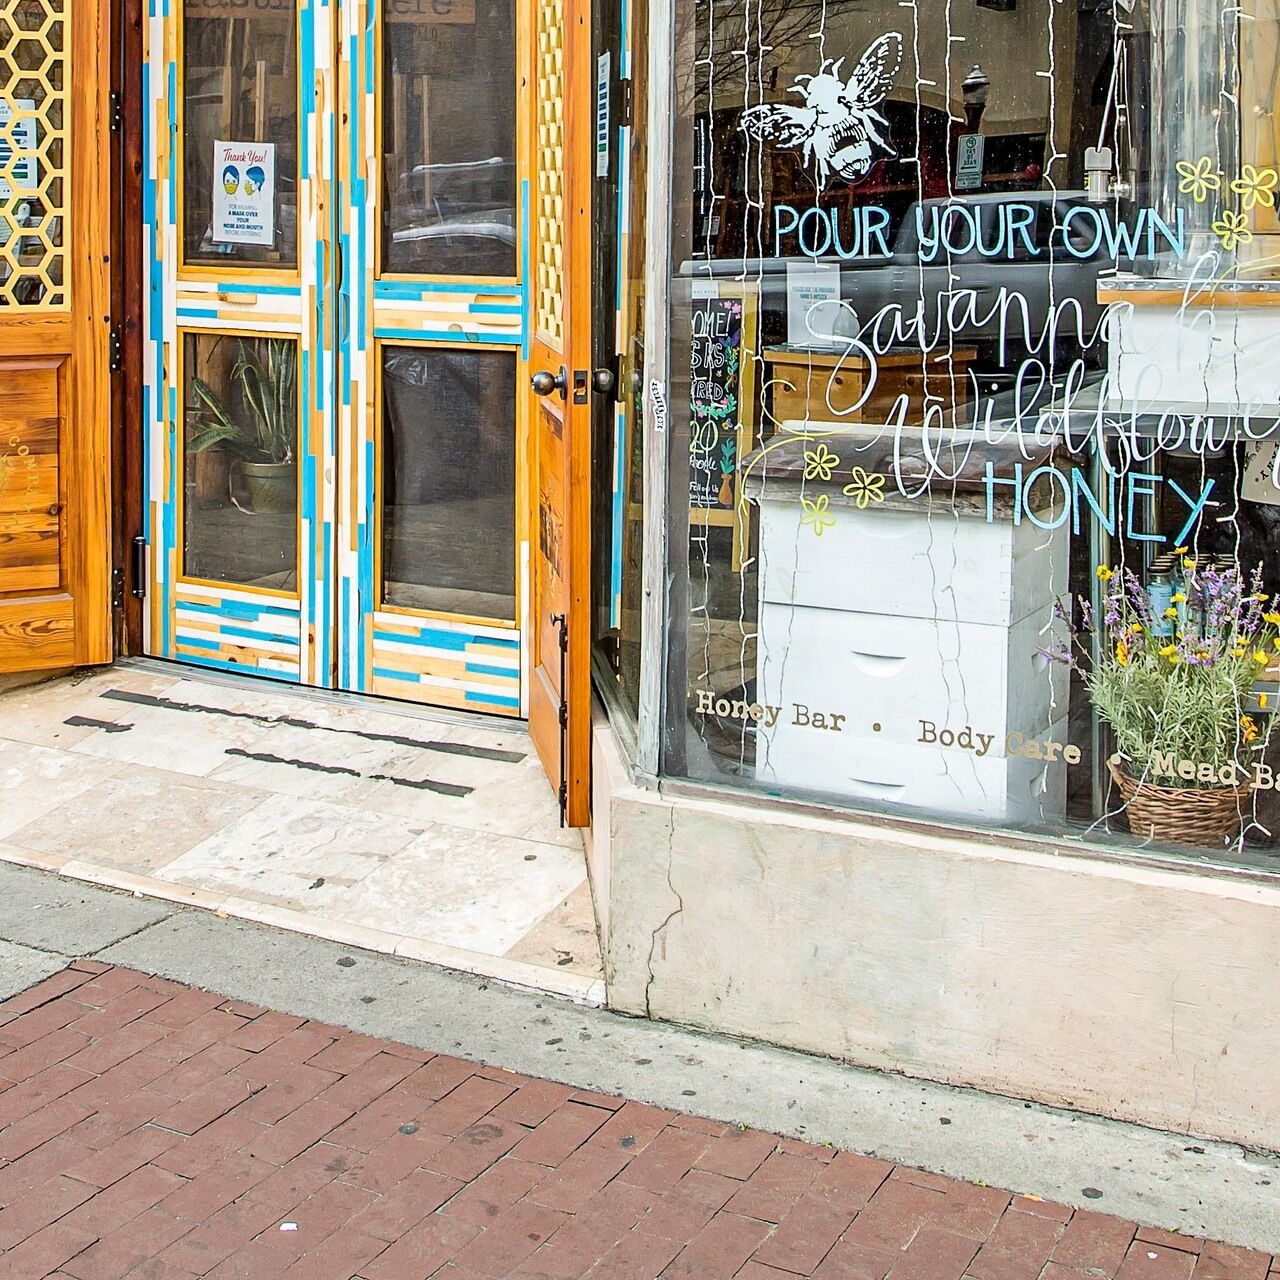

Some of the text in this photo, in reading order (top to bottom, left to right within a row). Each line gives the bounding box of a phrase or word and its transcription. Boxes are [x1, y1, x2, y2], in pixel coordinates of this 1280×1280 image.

[223, 148, 267, 166] Thank You!
[774, 203, 1185, 263] POUR YOUR OWN
[691, 310, 732, 338] OME!
[805, 249, 1220, 417] Savannah
[691, 340, 725, 369] SKS
[689, 420, 719, 453] 20
[982, 461, 1217, 547] HONEY
[695, 689, 783, 728] Honey
[791, 703, 846, 732] Bar
[917, 719, 996, 757] Body
[1006, 731, 1082, 765] Care
[1150, 749, 1241, 787] Mead
